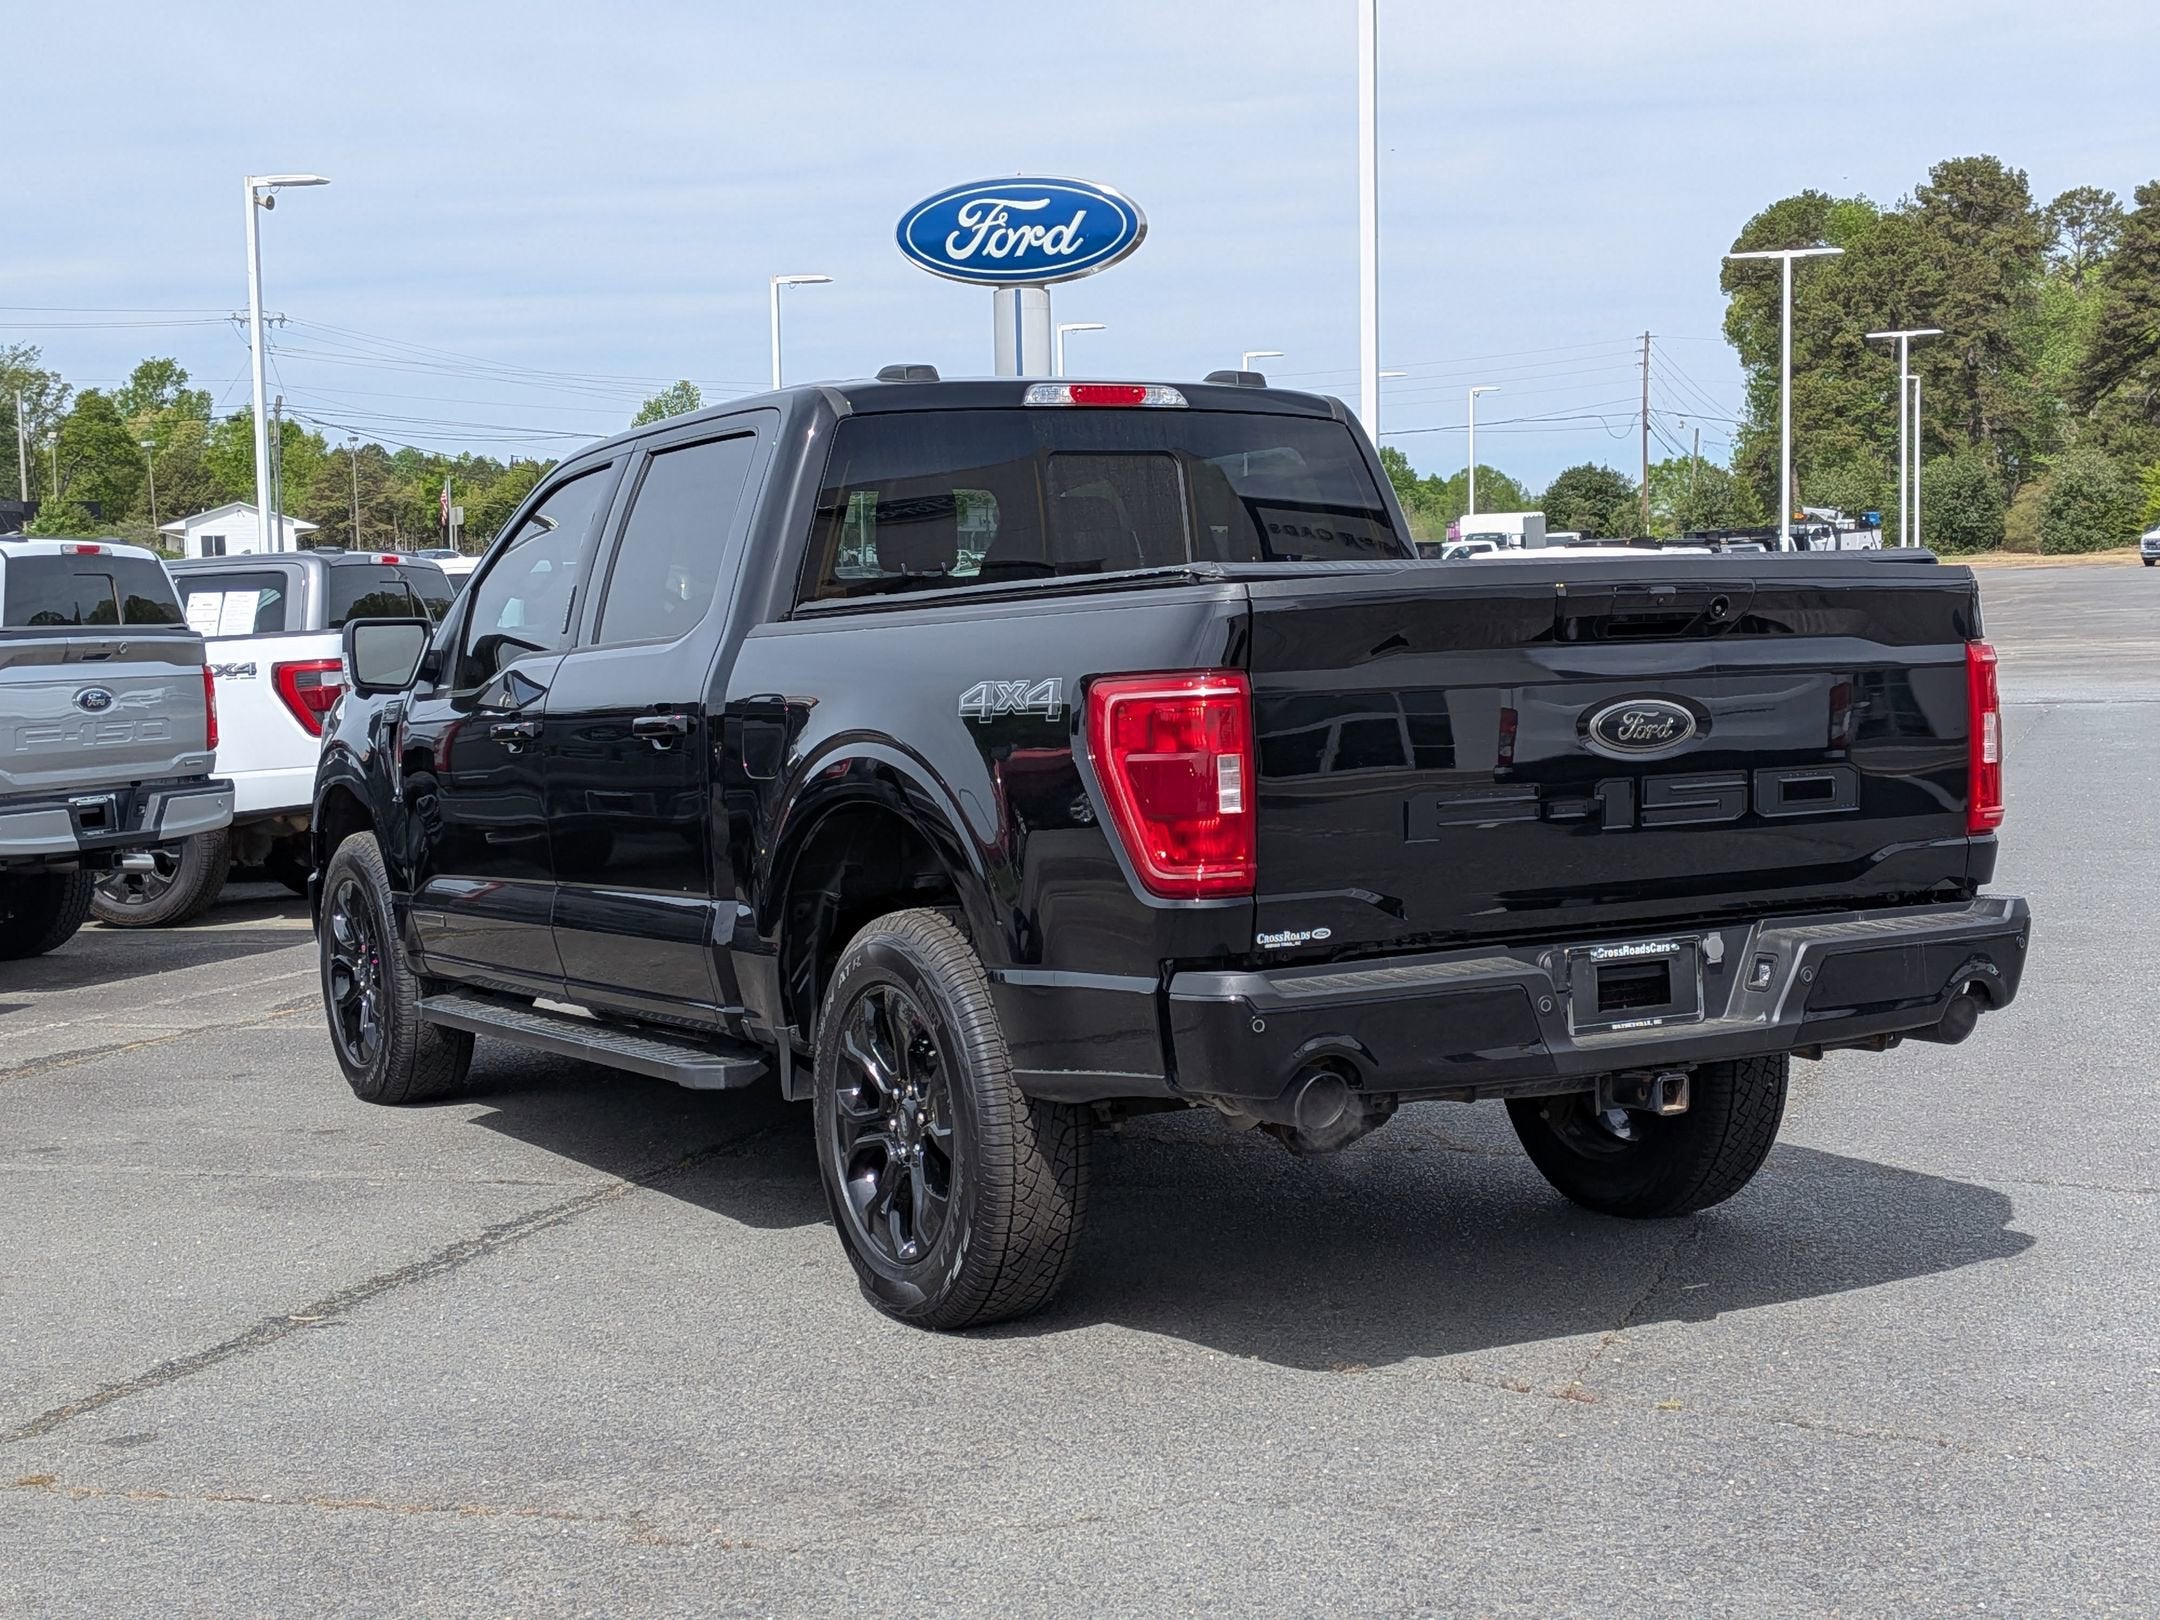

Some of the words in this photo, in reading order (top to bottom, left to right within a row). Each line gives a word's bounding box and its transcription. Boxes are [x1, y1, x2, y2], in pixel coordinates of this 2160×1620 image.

[945, 198, 1087, 260] Ford
[15, 717, 172, 751] F-150
[1618, 711, 1675, 740] Ford
[1403, 762, 1861, 844] F-150
